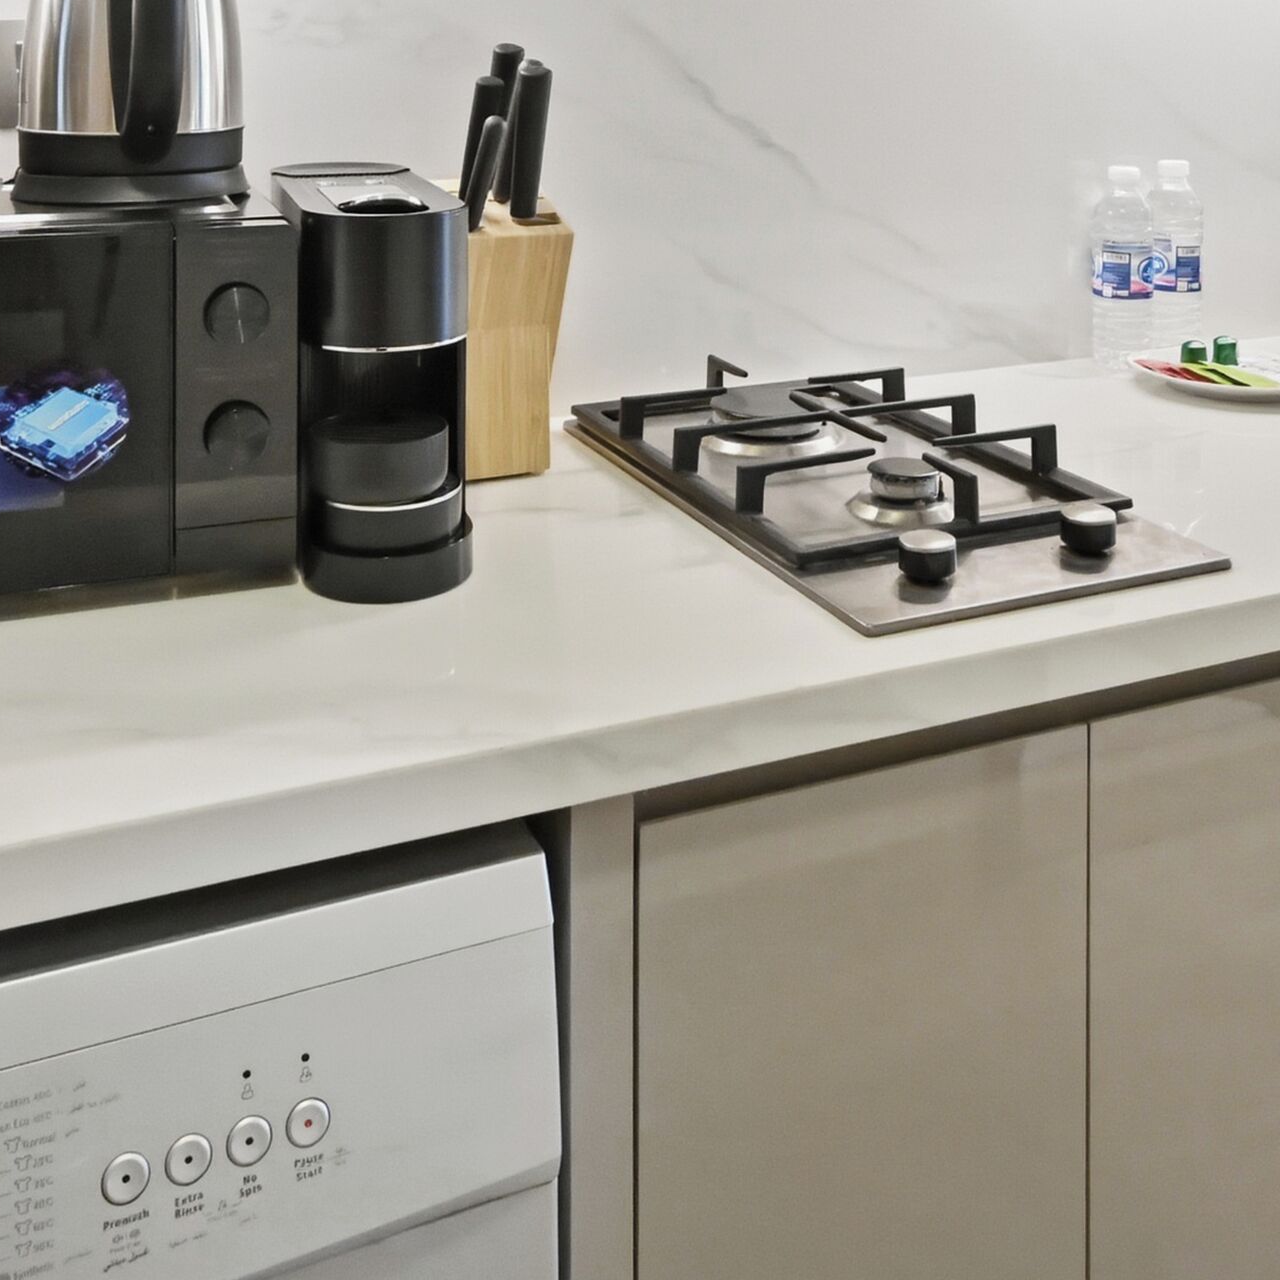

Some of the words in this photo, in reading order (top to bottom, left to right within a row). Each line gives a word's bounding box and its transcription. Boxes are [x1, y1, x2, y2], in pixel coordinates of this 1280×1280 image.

[243, 1174, 258, 1185] No
[174, 1190, 205, 1208] Extra
[239, 1184, 263, 1199] Spin
[174, 1203, 205, 1219] Rinse
